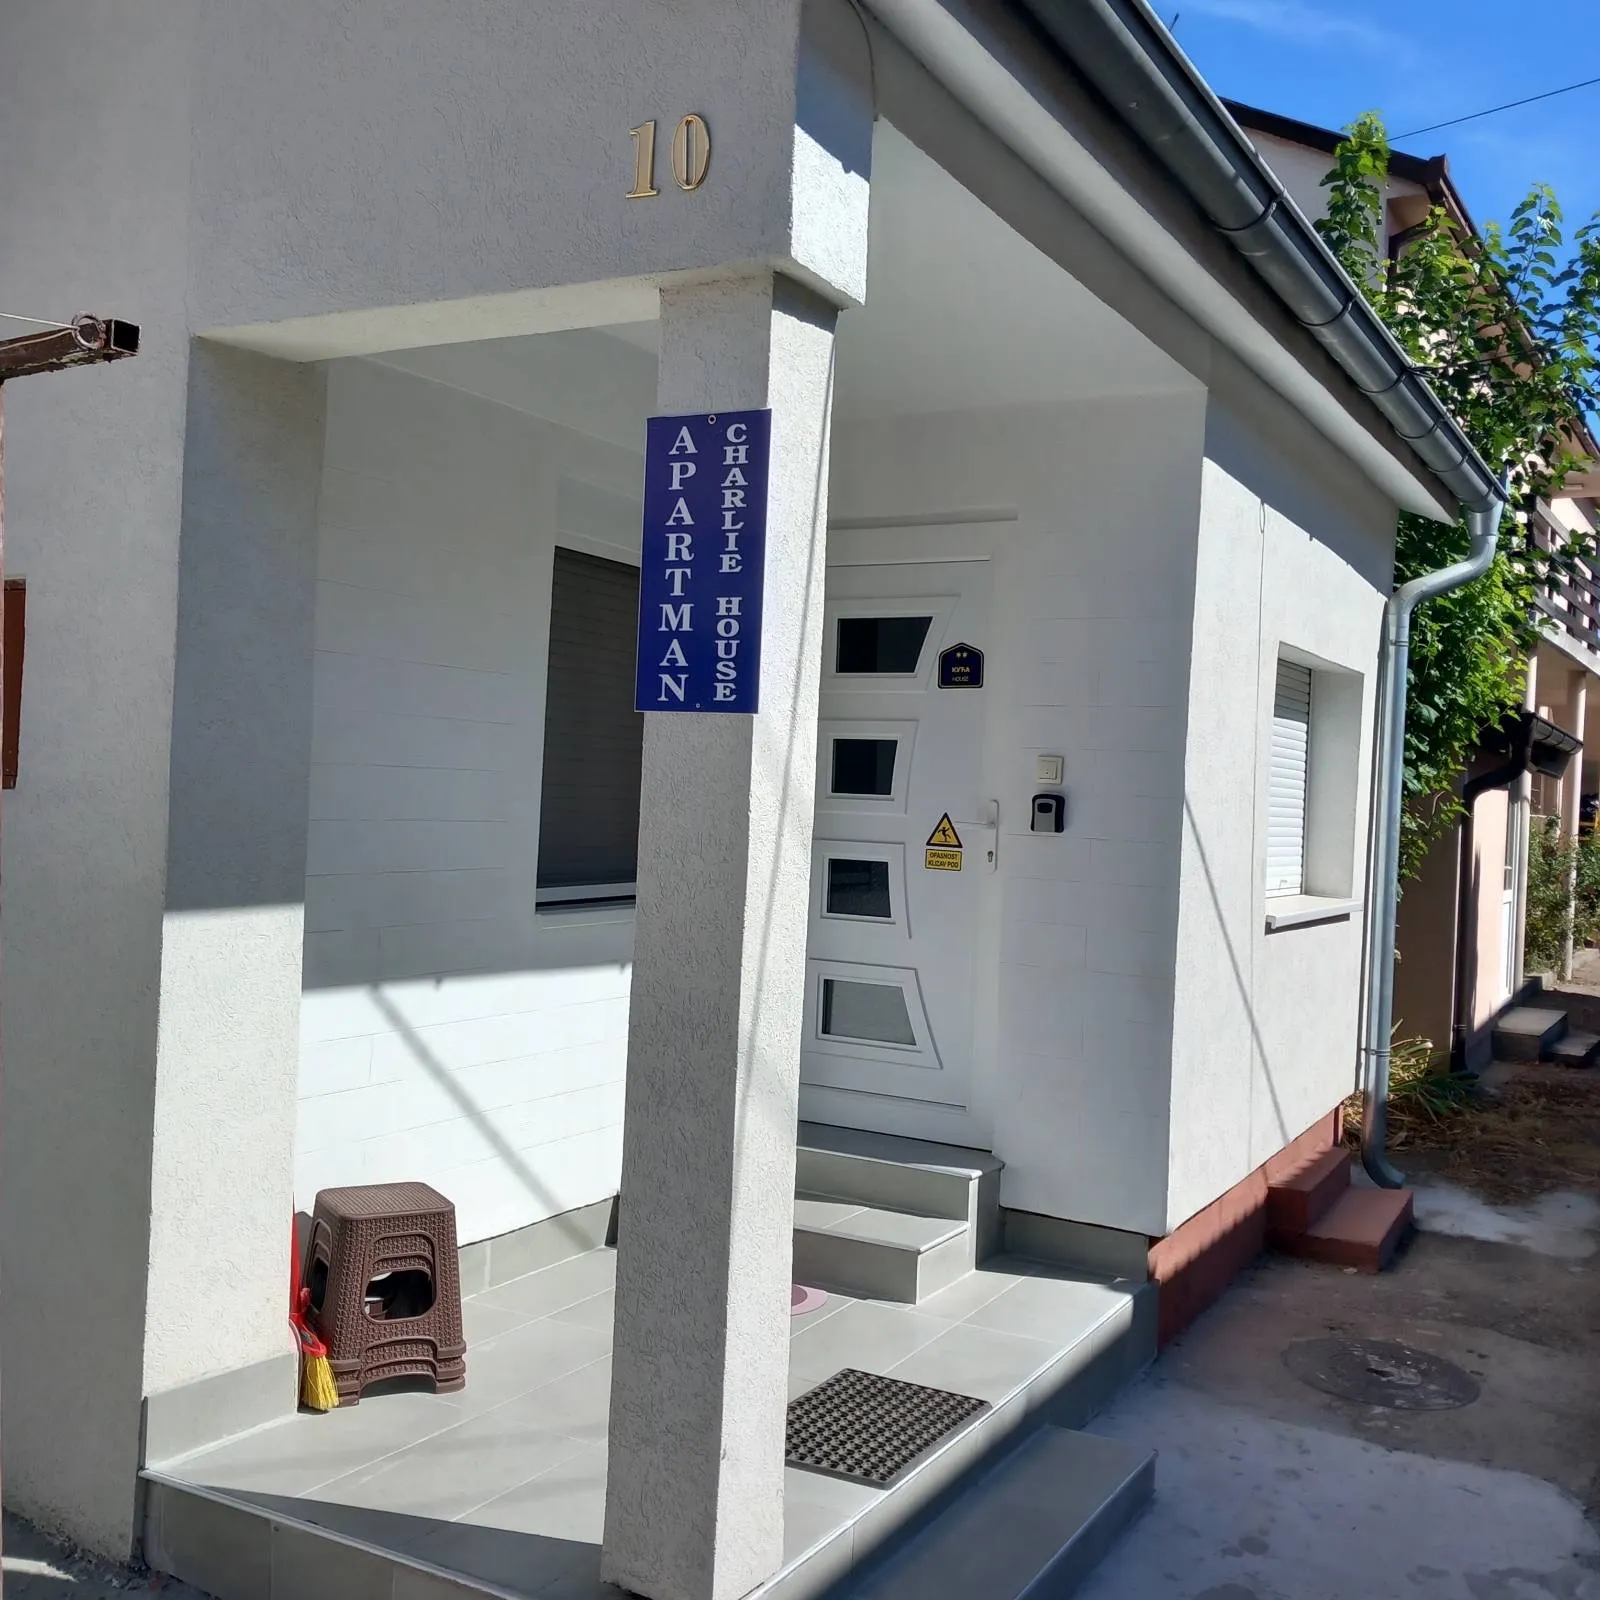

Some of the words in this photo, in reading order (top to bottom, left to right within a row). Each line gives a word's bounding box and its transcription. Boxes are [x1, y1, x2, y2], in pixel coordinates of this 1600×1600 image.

[625, 113, 711, 198] 10
[718, 423, 750, 574] CHARLIE
[657, 425, 698, 702] APARTMAN
[713, 596, 743, 702] HOUSE
[929, 851, 958, 860] OPASNOST
[947, 861, 959, 869] POD
